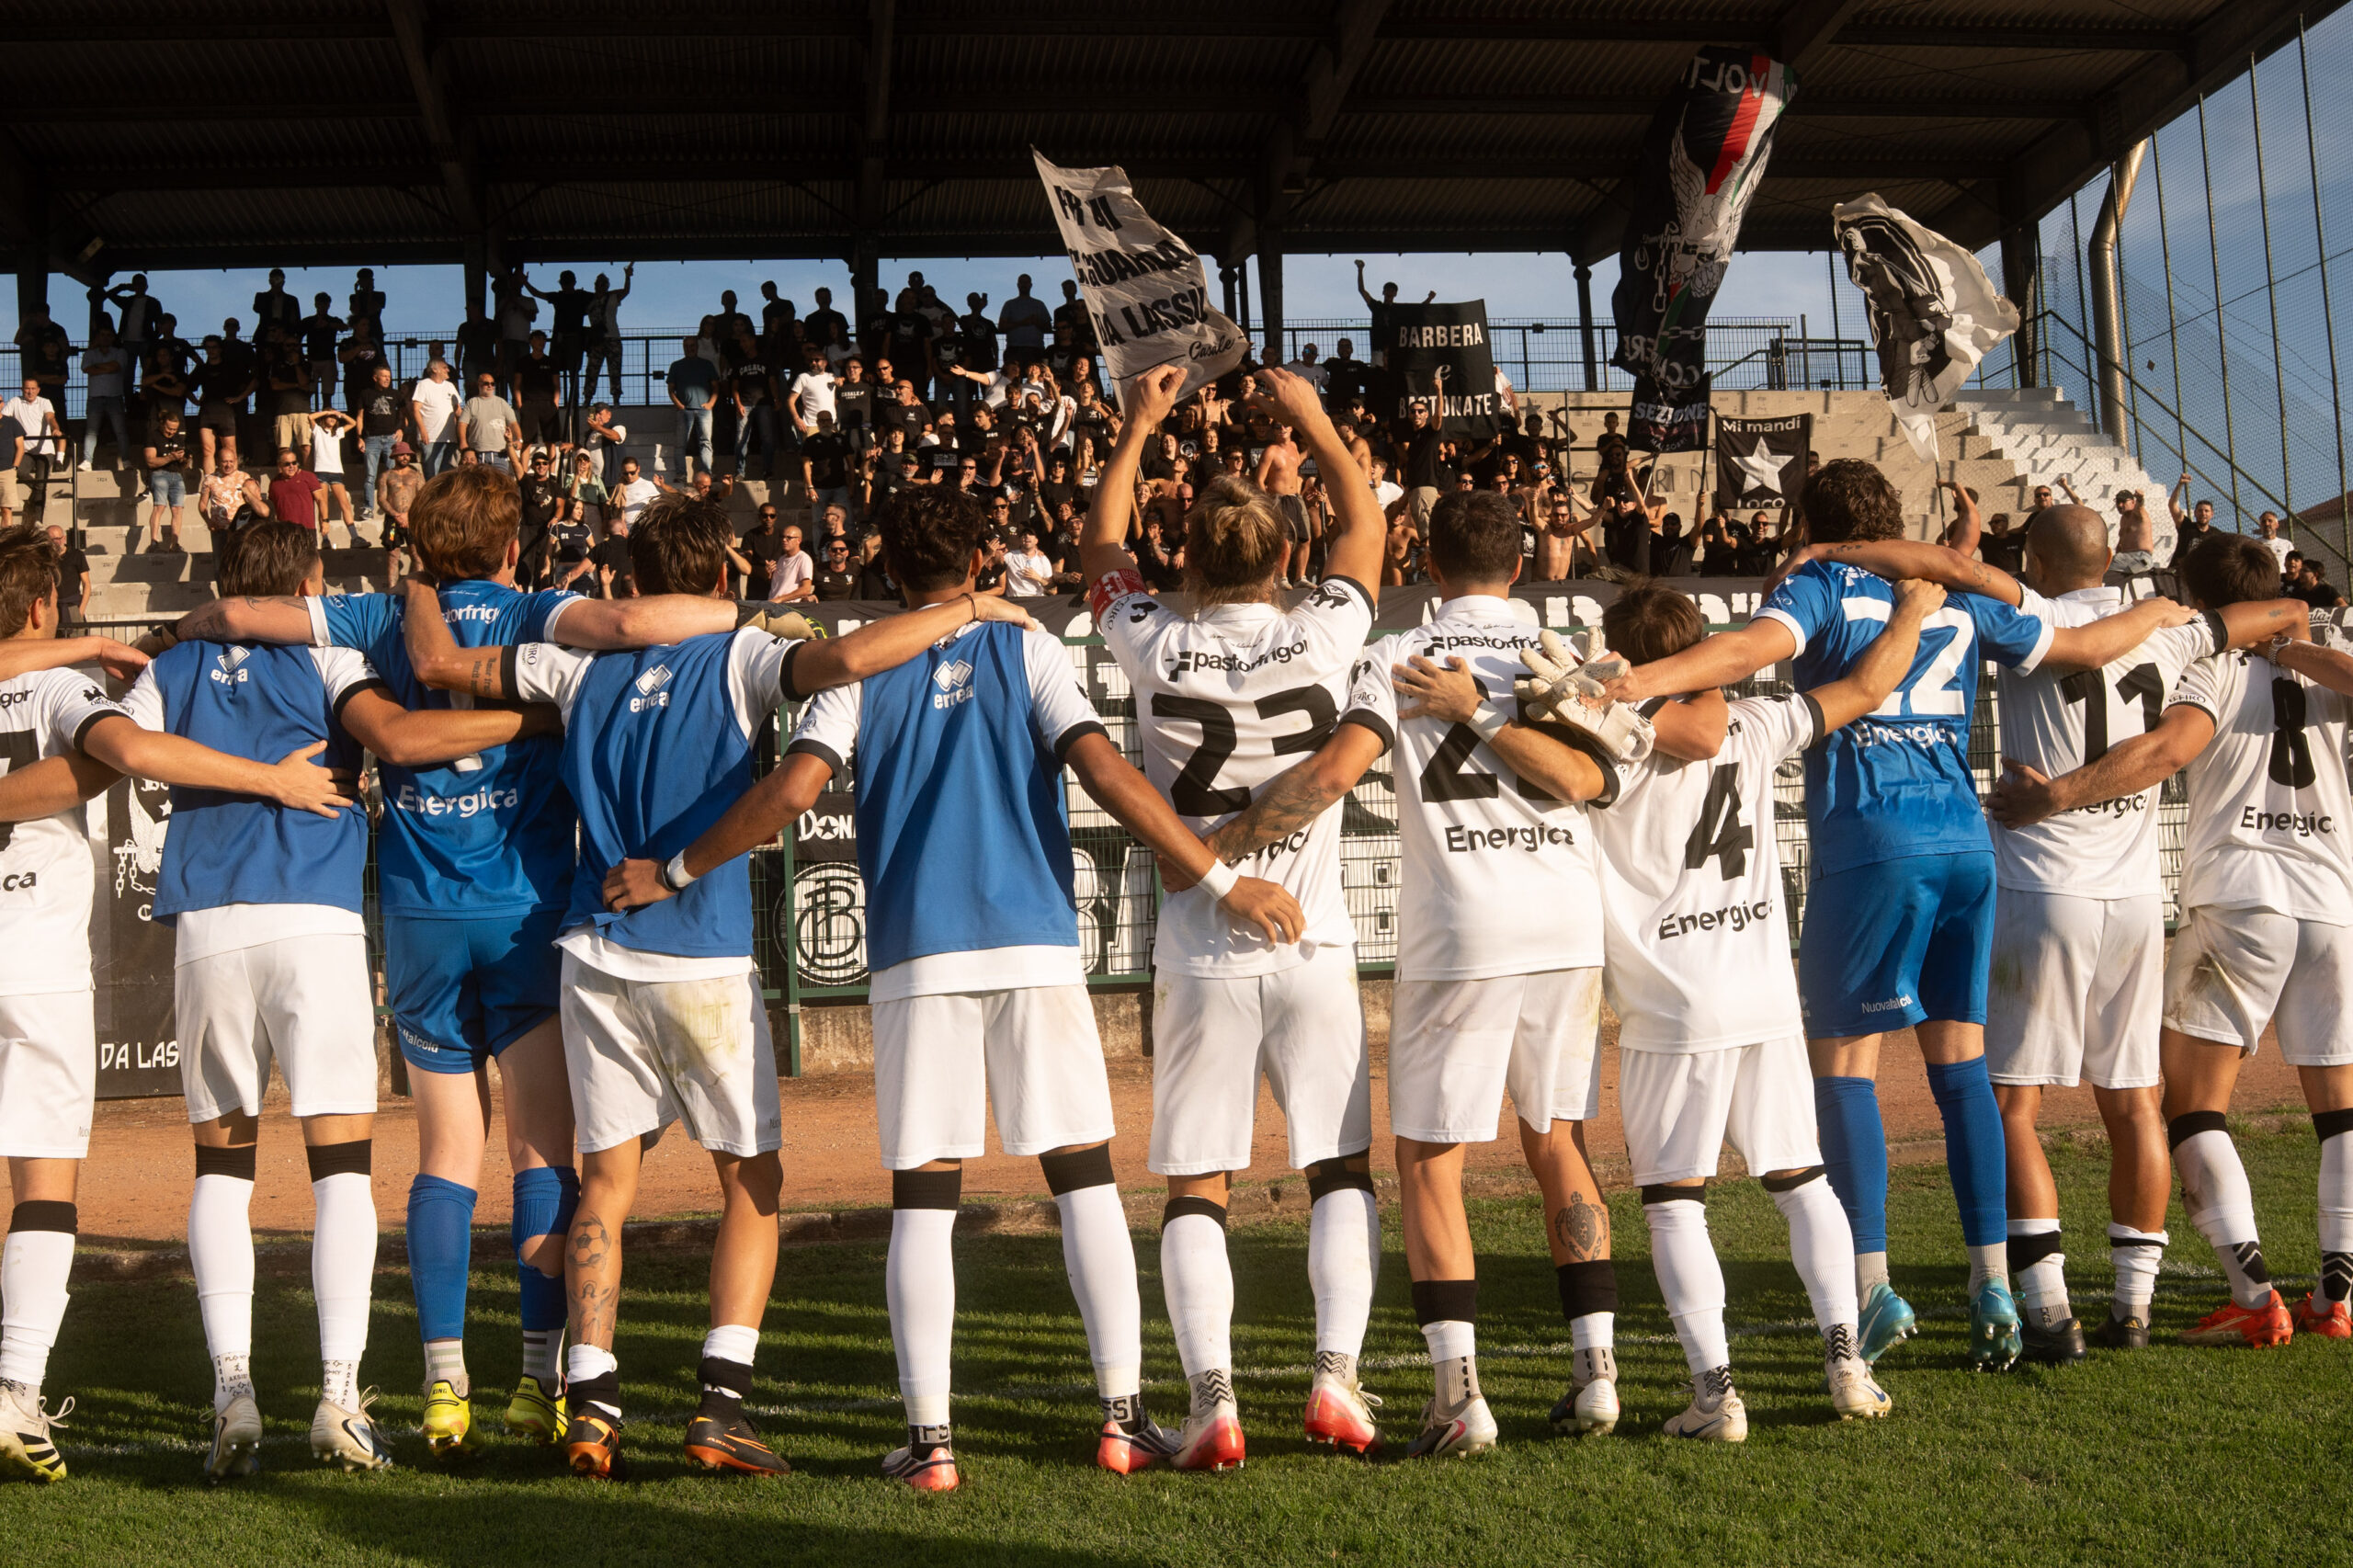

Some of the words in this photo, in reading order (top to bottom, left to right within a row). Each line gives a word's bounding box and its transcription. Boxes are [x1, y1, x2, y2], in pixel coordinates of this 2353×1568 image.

[1092, 312, 1126, 347] DA
[1120, 280, 1209, 339] LASSÙ
[1188, 335, 1235, 360] Casale
[1399, 323, 1483, 347] BARBERA
[1434, 364, 1451, 381] e
[1399, 393, 1492, 419] BTONATE
[1634, 403, 1707, 424] SEZIONE
[1722, 420, 1742, 432] Mi
[1746, 416, 1802, 432] mandi
[2268, 676, 2316, 790] 8
[1151, 685, 1340, 816] 23
[397, 785, 518, 818] Energica
[799, 808, 857, 842] DON
[1686, 763, 1754, 881] 4
[101, 1042, 130, 1071] DA
